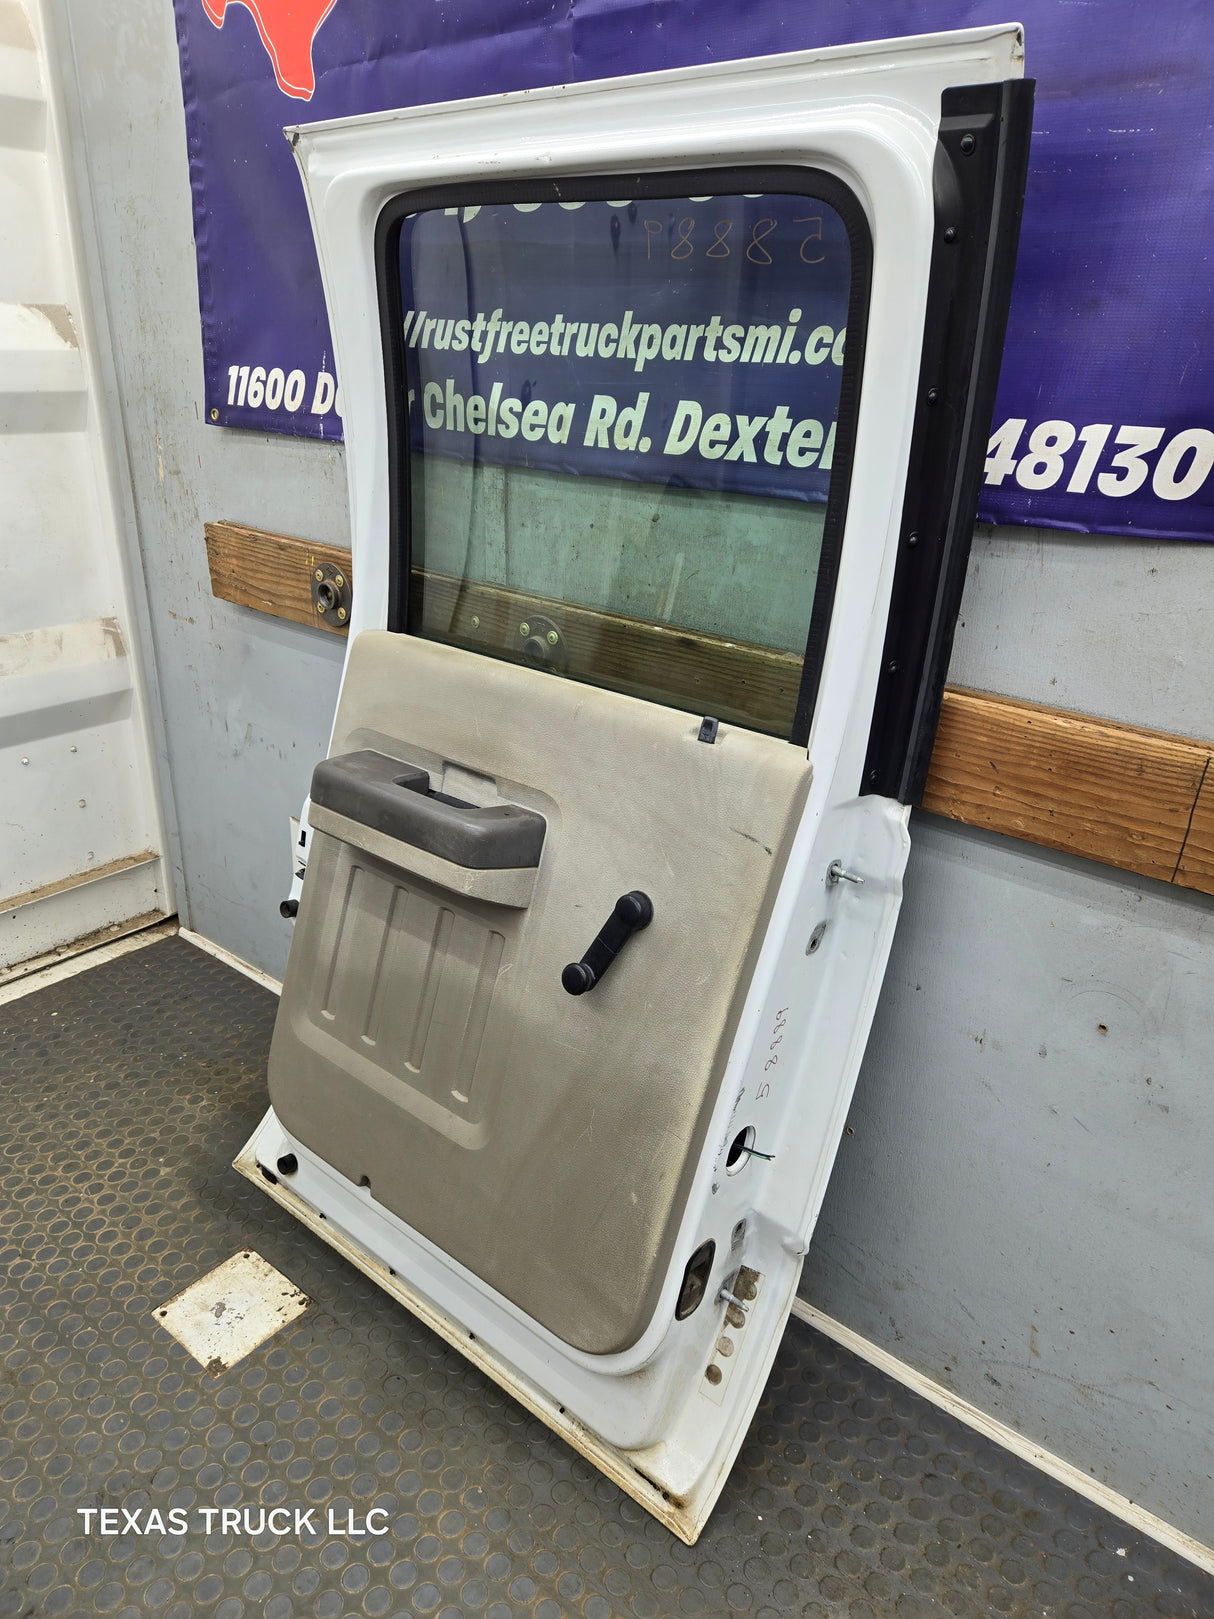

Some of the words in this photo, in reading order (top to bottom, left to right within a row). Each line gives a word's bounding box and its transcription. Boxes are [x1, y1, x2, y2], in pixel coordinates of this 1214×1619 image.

[227, 365, 306, 412] 11600
[423, 378, 575, 444] Chelsea
[583, 392, 652, 453] Rd.
[983, 418, 1214, 501] 48130
